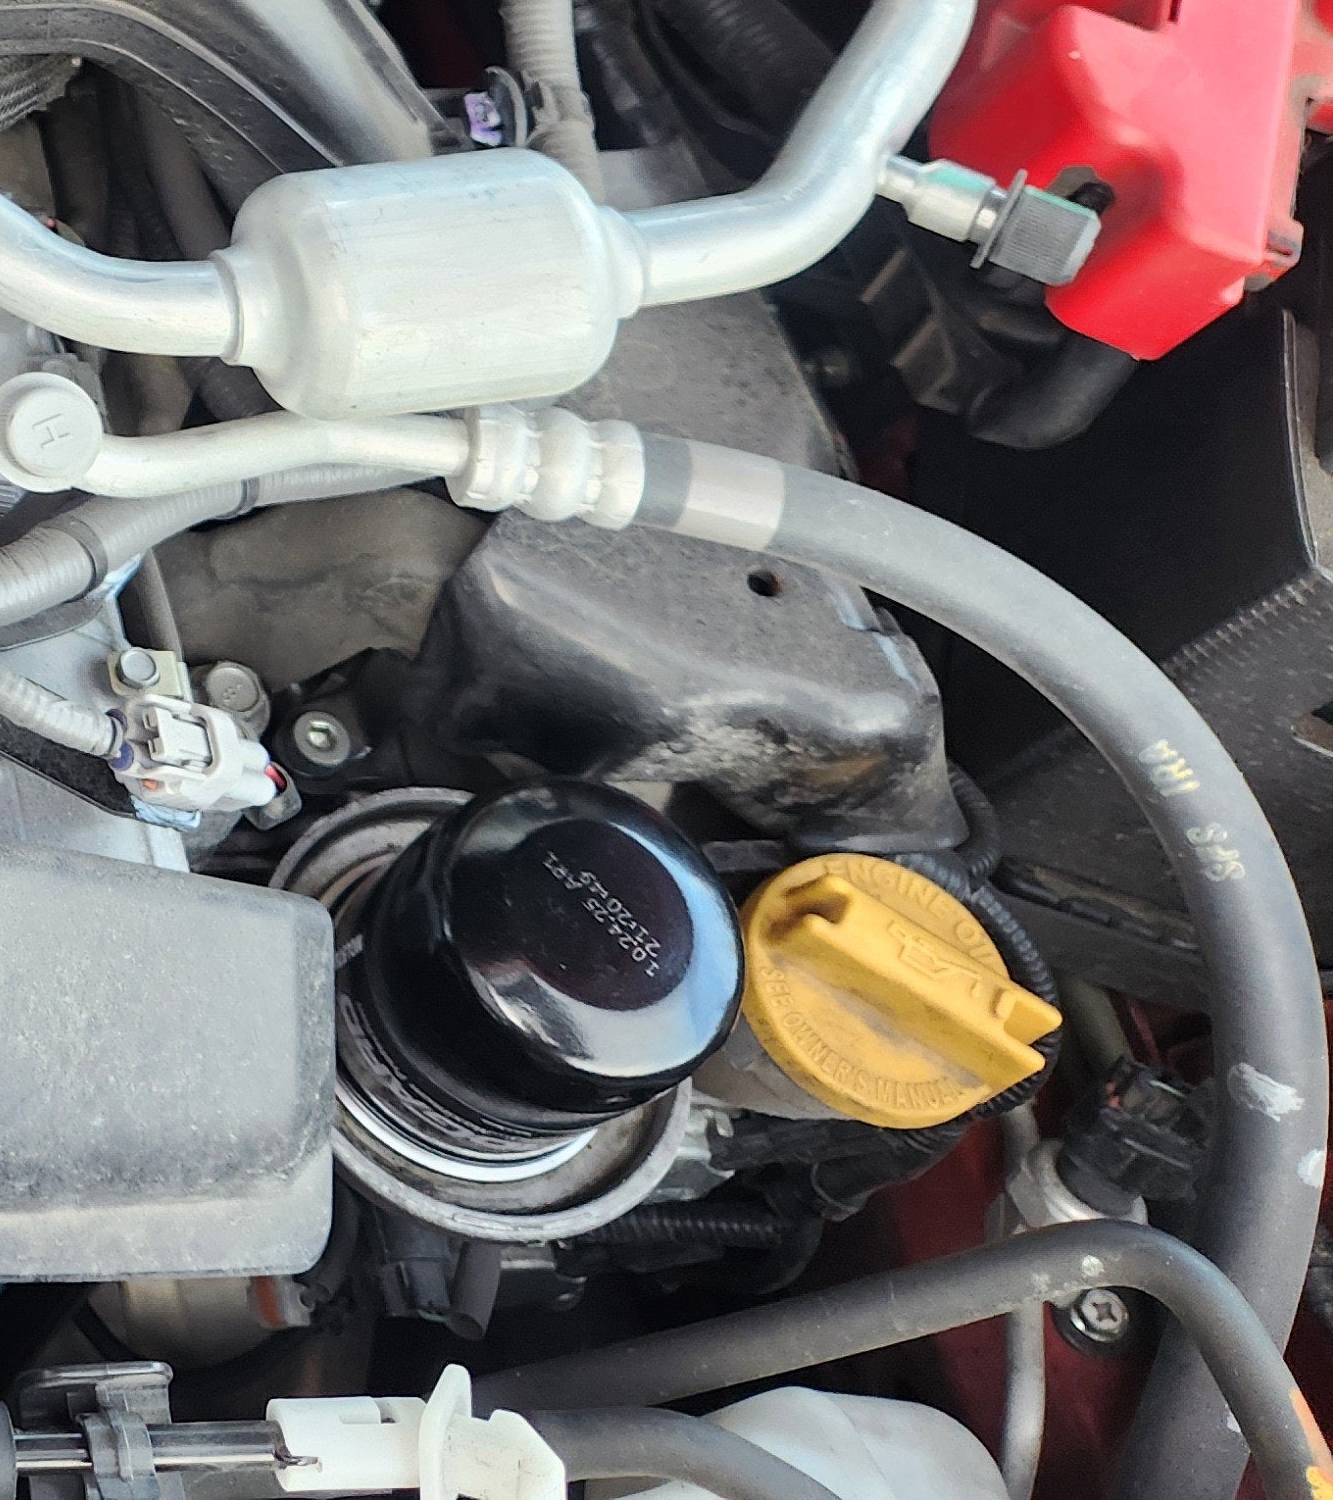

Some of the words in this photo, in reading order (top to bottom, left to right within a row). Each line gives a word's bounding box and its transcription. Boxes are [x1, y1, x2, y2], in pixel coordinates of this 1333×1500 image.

[33, 413, 70, 449] H
[760, 965, 796, 1008] SEE
[783, 1010, 870, 1092] OWNER'S
